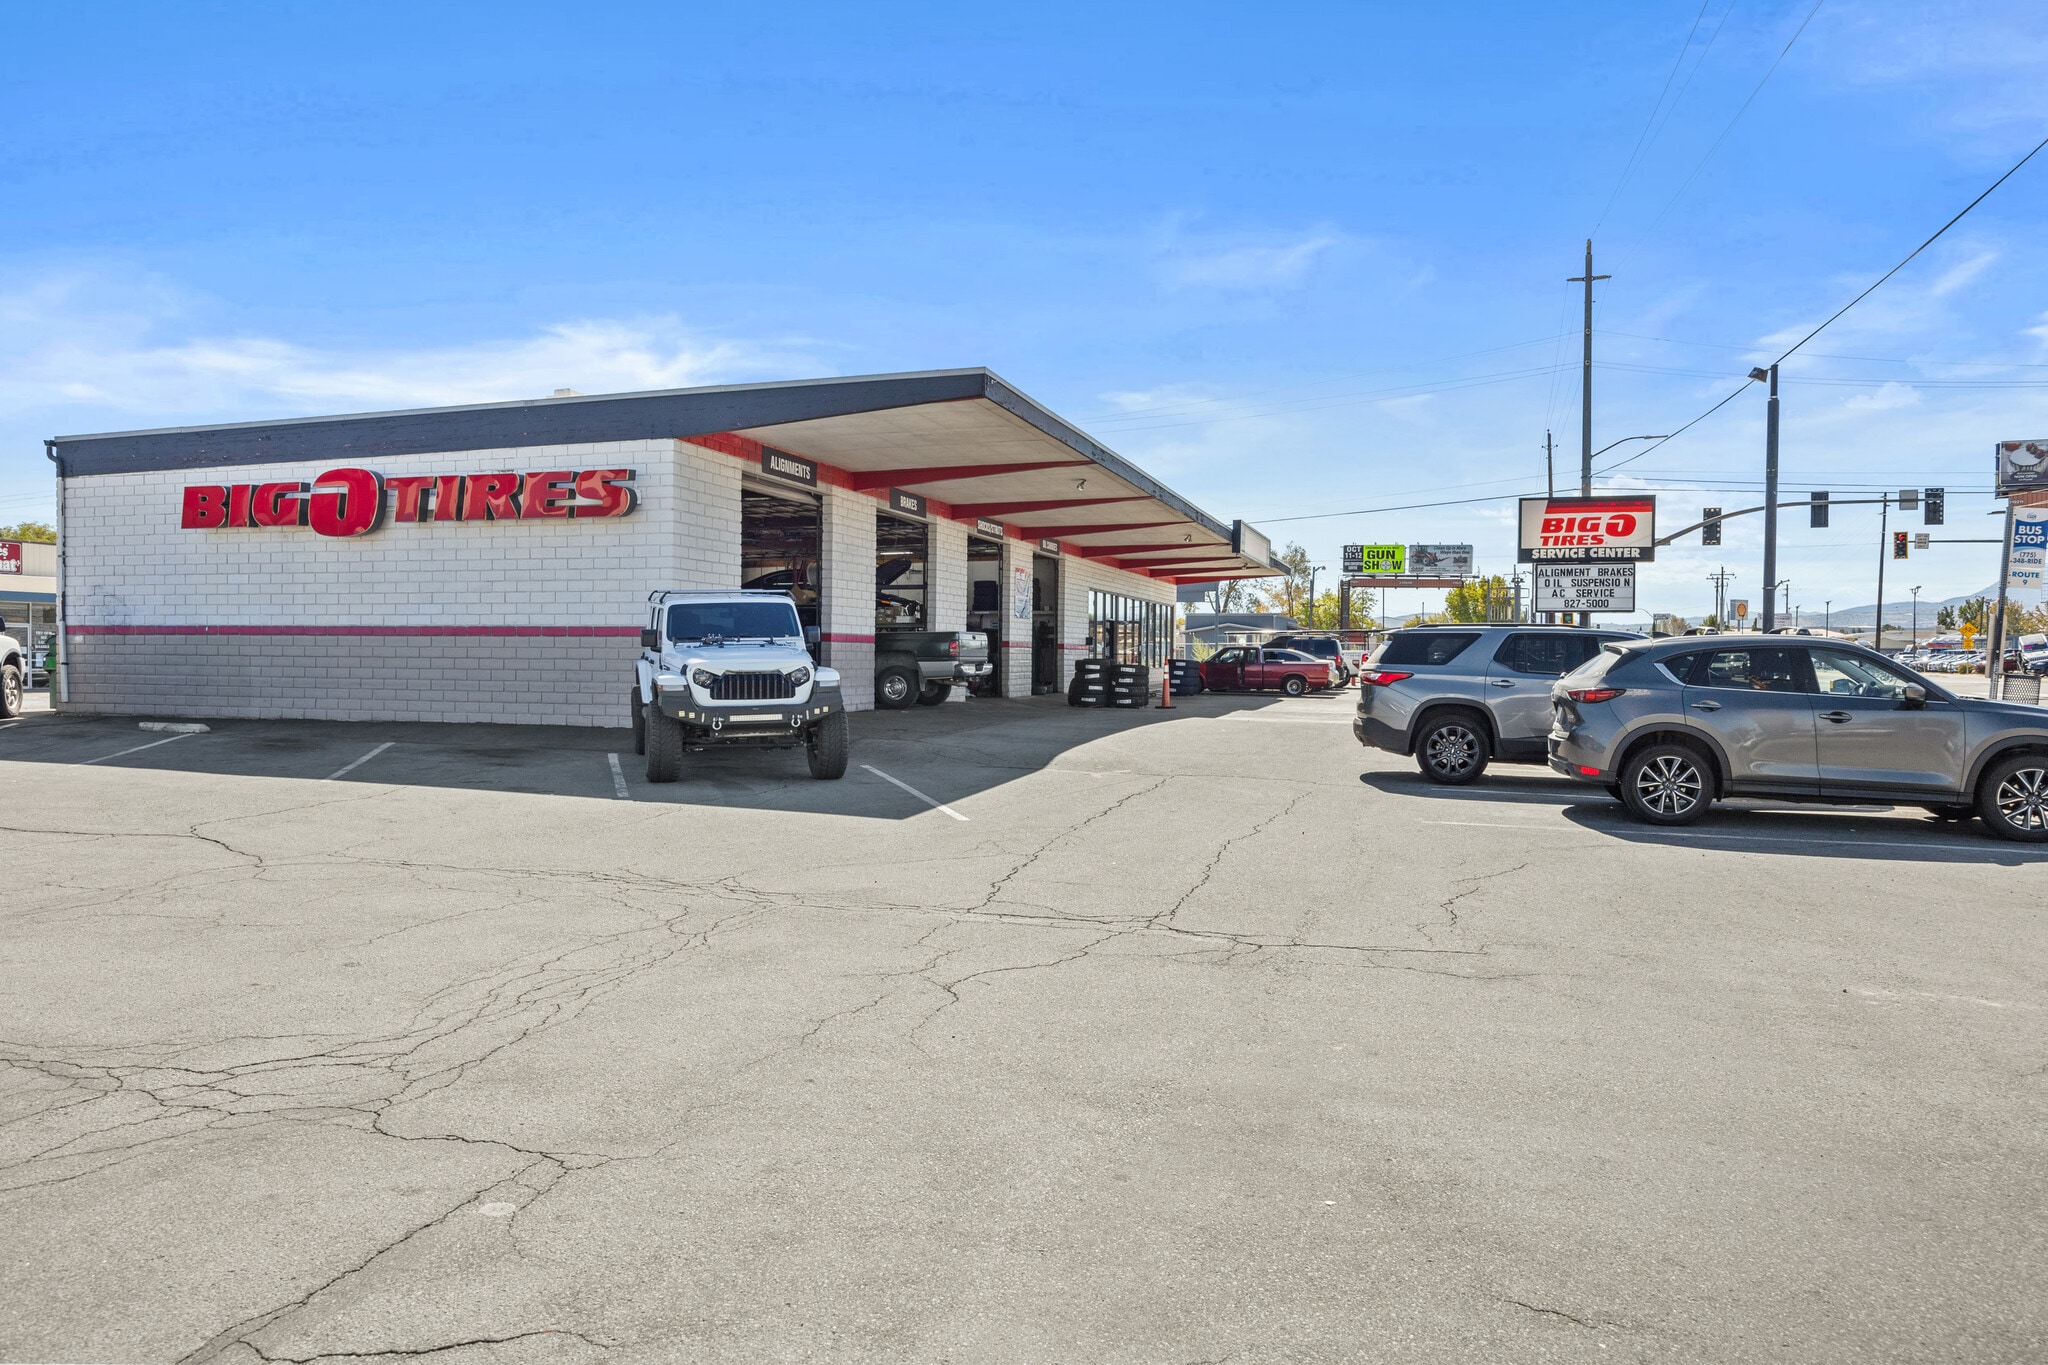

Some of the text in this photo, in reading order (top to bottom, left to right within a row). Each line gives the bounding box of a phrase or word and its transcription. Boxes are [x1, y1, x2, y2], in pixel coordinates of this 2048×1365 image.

[770, 455, 811, 480] ALIGNMENTS
[181, 468, 636, 537] BIG O TIRES
[900, 495, 918, 511] BRAKES
[1540, 514, 1637, 537] BIG O
[2018, 525, 2043, 535] BUS
[1539, 534, 1605, 547] TIRES
[2014, 535, 2046, 544] STOP
[1367, 550, 1395, 560] GUN
[1531, 547, 1641, 559] SERVICE CENTER
[1538, 567, 1634, 577] ALIGNMENT BRAKES
[2011, 571, 2040, 579] ROUTE
[1551, 588, 1615, 598] AC SERVICE
[1563, 599, 1609, 608] 827-5000
